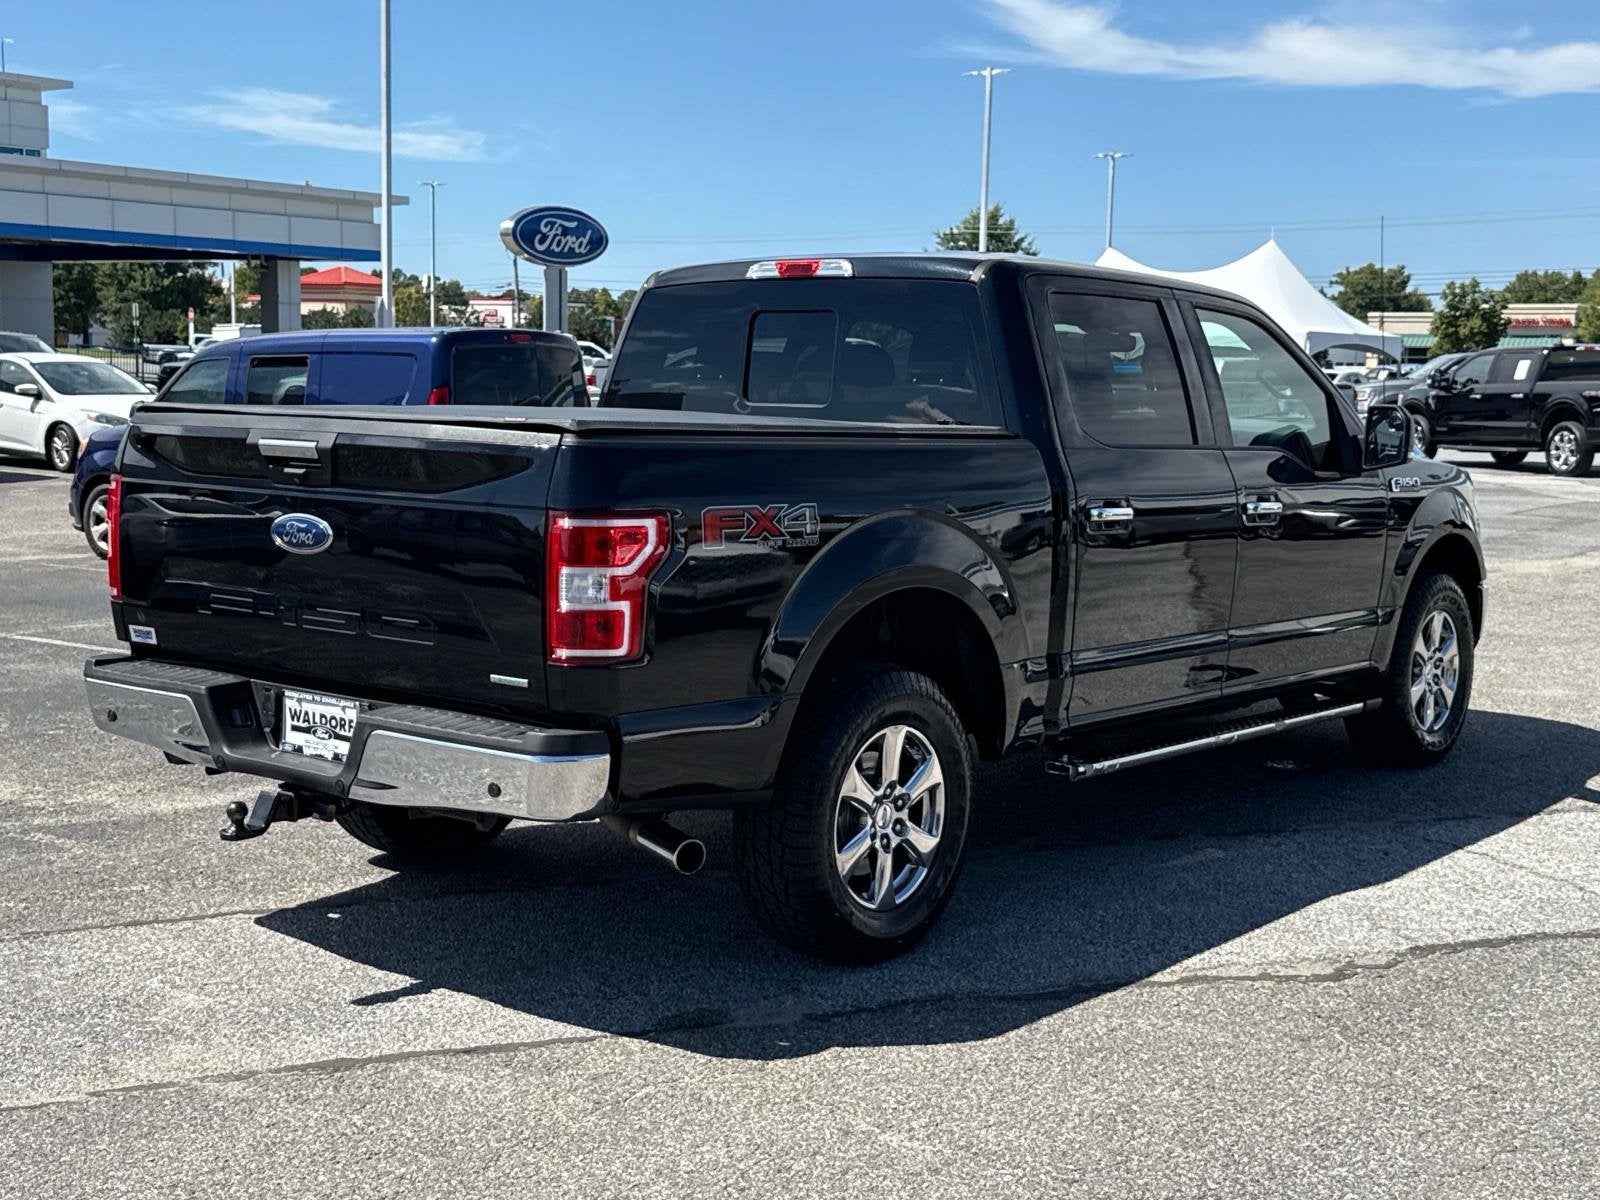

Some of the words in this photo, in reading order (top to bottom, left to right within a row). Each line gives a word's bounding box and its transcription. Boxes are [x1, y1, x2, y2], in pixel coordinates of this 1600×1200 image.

[534, 218, 592, 254] Ford
[283, 521, 316, 545] Ford
[701, 503, 820, 549] FX4
[288, 706, 354, 733] WALDORF
